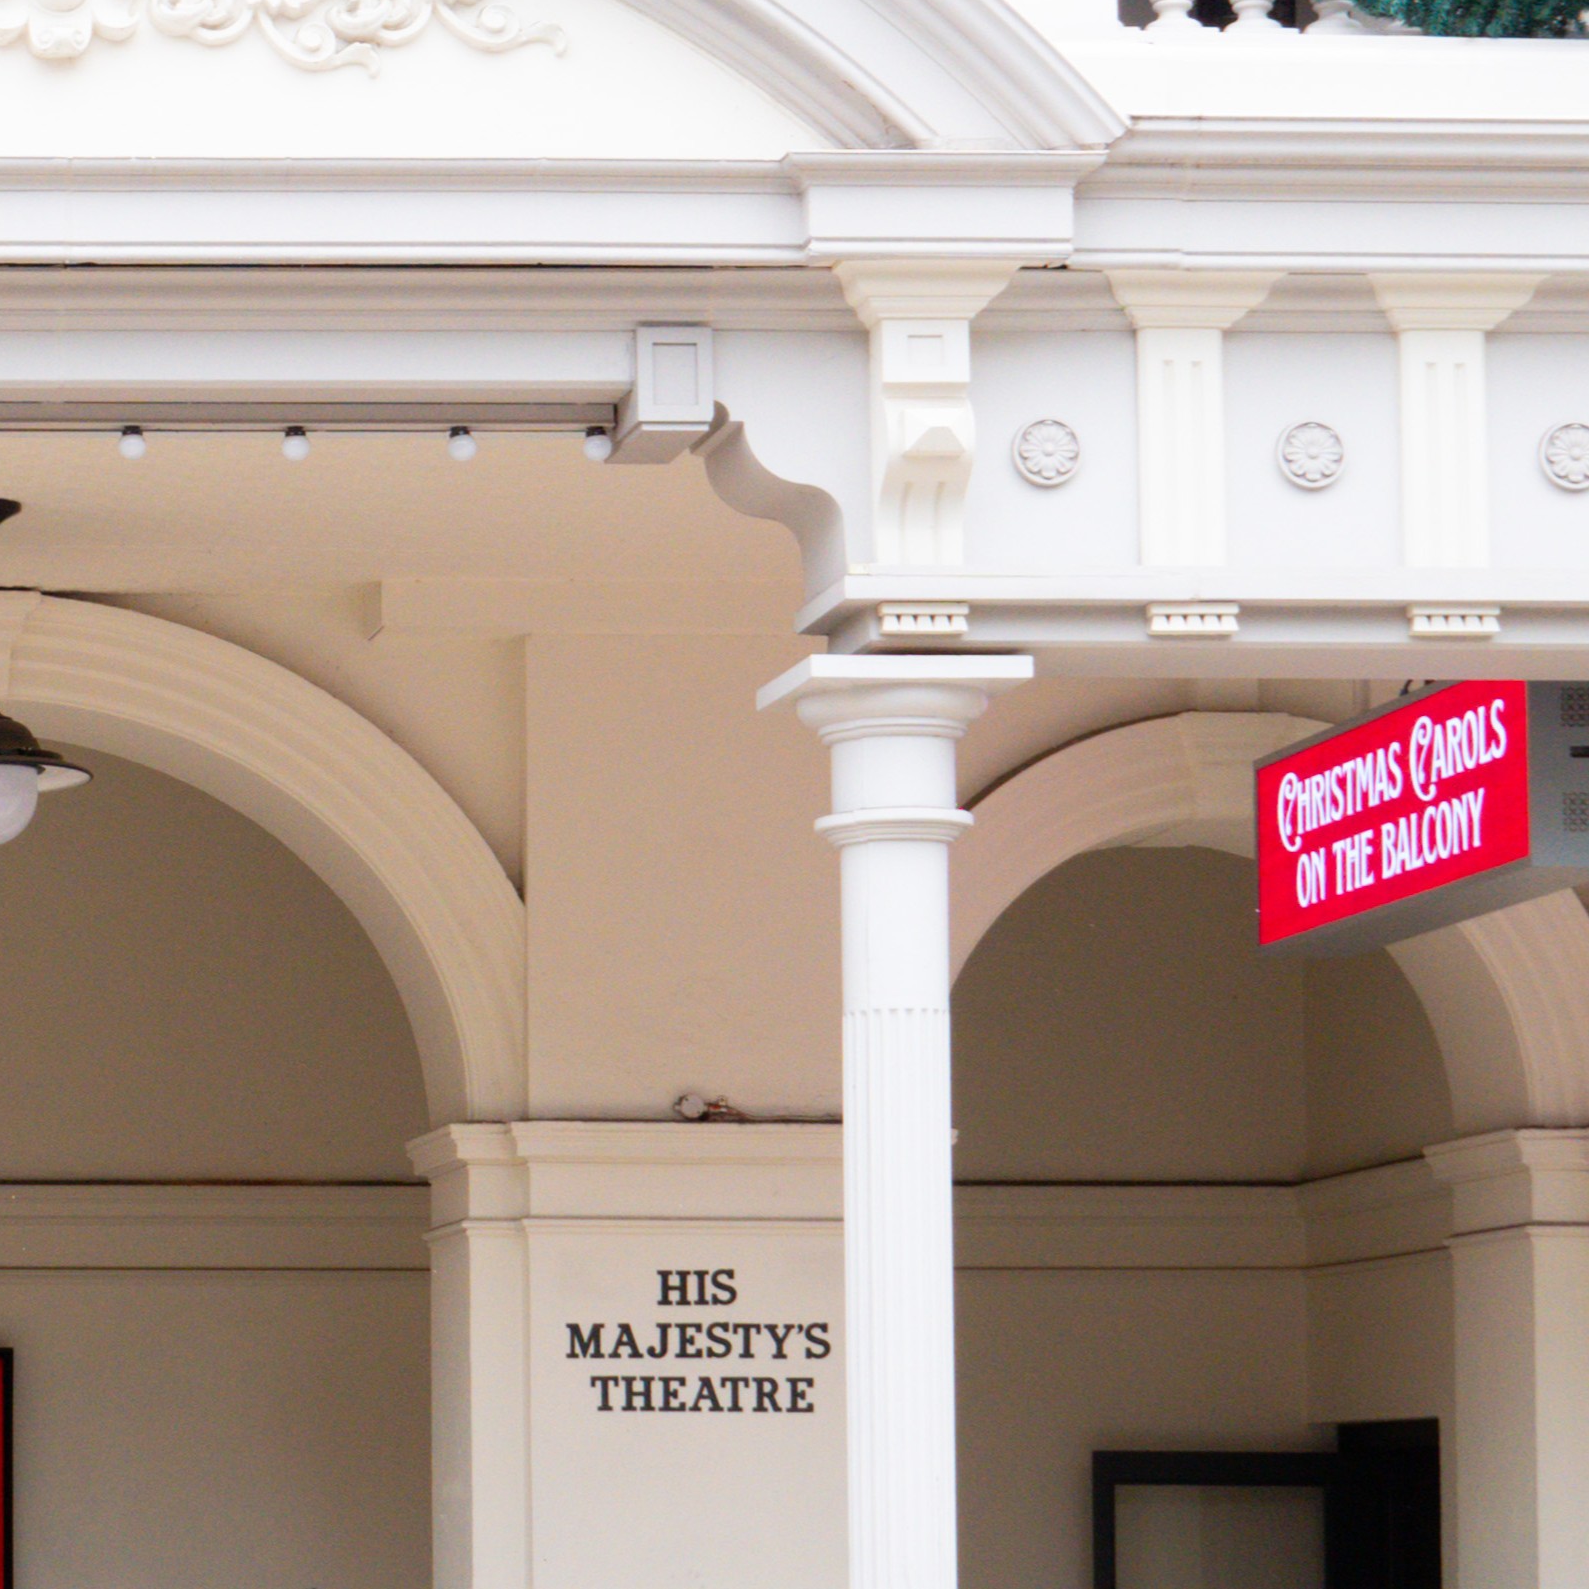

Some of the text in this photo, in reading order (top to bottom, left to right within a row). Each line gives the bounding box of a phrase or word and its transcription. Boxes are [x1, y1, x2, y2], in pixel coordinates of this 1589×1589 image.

[1277, 699, 1507, 852] CHRISTMAS CAROLS
[1296, 787, 1485, 908] ON THE BALCONY
[656, 1269, 737, 1306] HIS
[565, 1322, 831, 1359] MAJESTY'S
[590, 1375, 815, 1413] THEATRE
